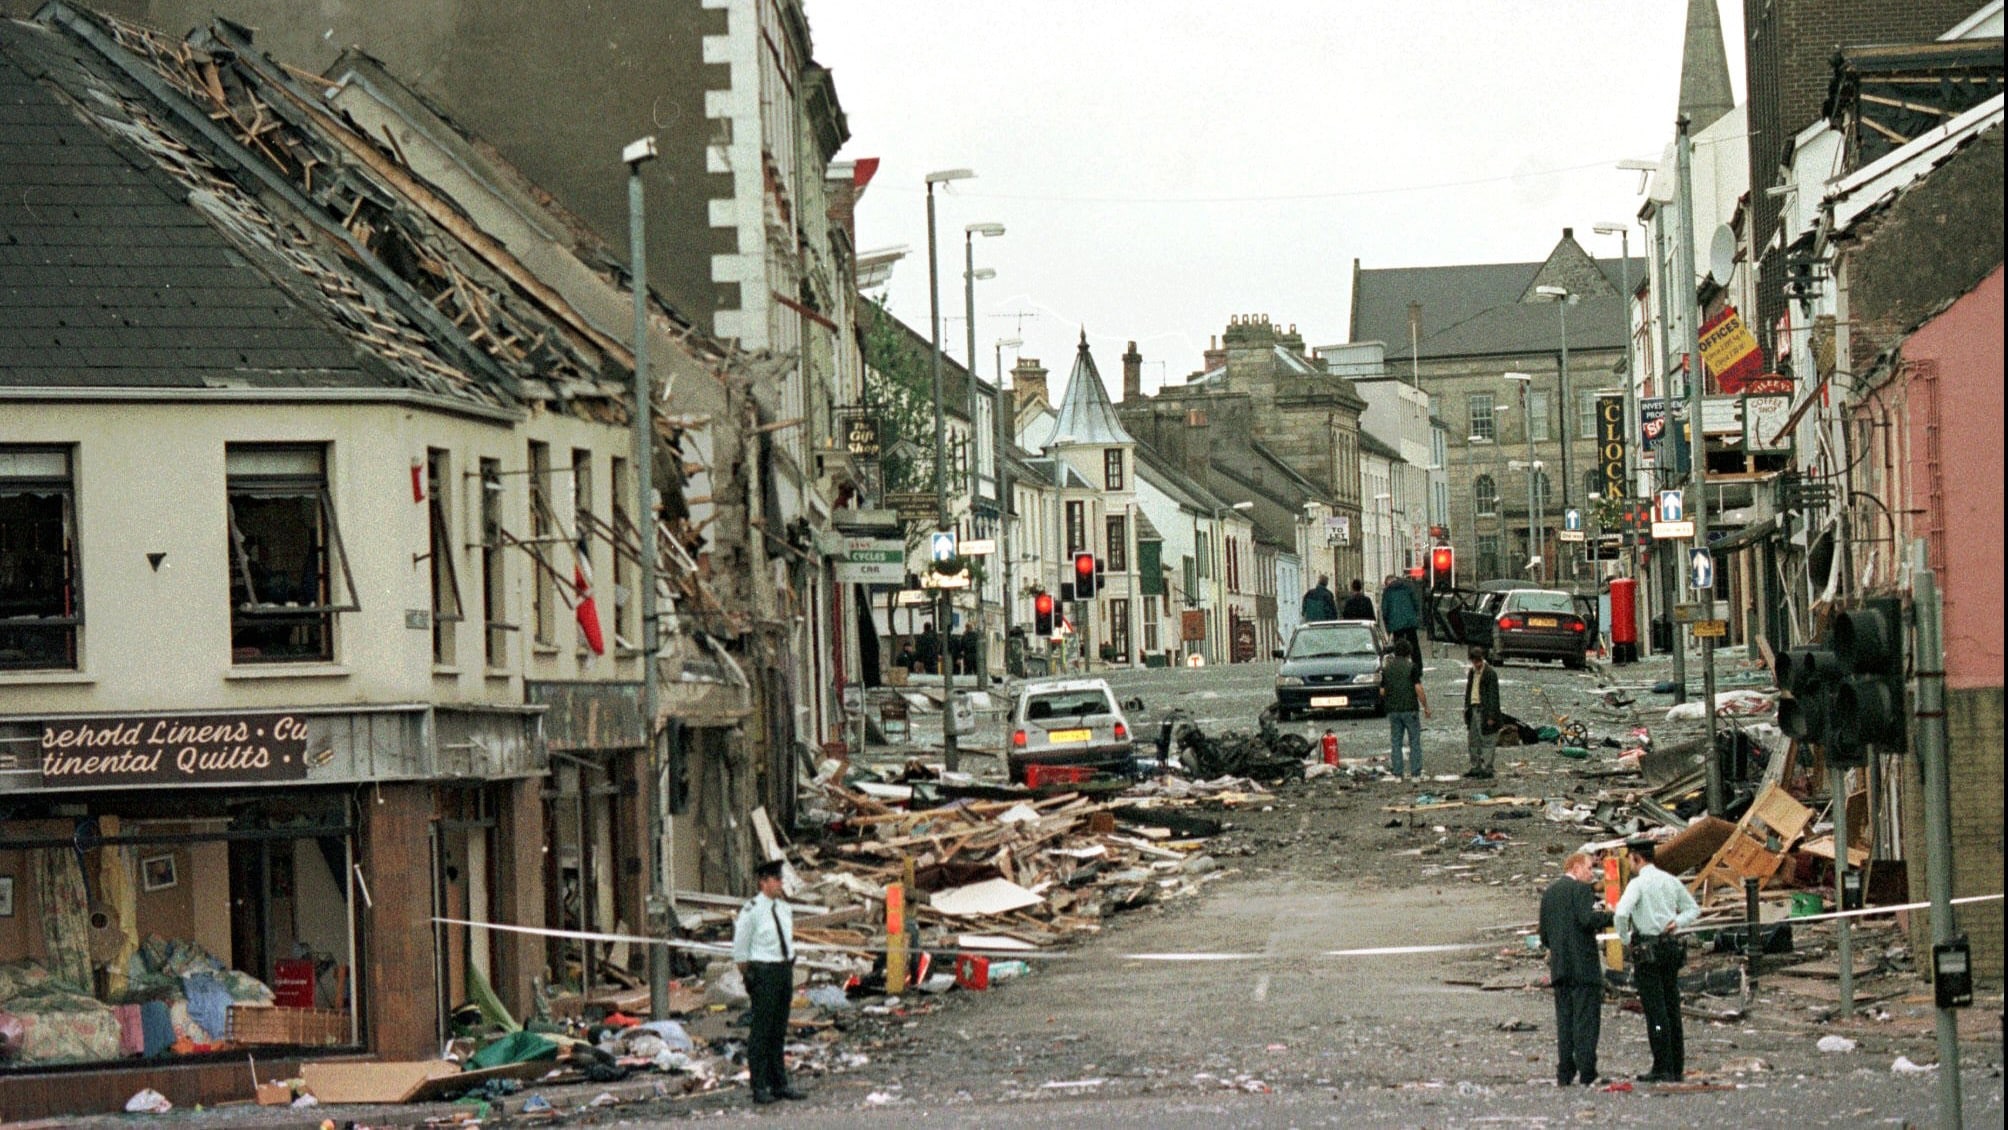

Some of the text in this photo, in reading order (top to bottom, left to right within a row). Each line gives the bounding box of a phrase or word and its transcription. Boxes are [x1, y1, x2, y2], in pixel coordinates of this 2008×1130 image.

[1699, 319, 1740, 352] OFFICES
[850, 431, 874, 443] Gift
[848, 443, 879, 454] Shop
[1605, 404, 1624, 498] CLOCK
[852, 552, 886, 561] CYCLES
[861, 565, 880, 573] CAR
[42, 722, 145, 748] sehold
[147, 719, 249, 745] Linens
[42, 748, 160, 776] tinental
[176, 745, 271, 774] Quilts
